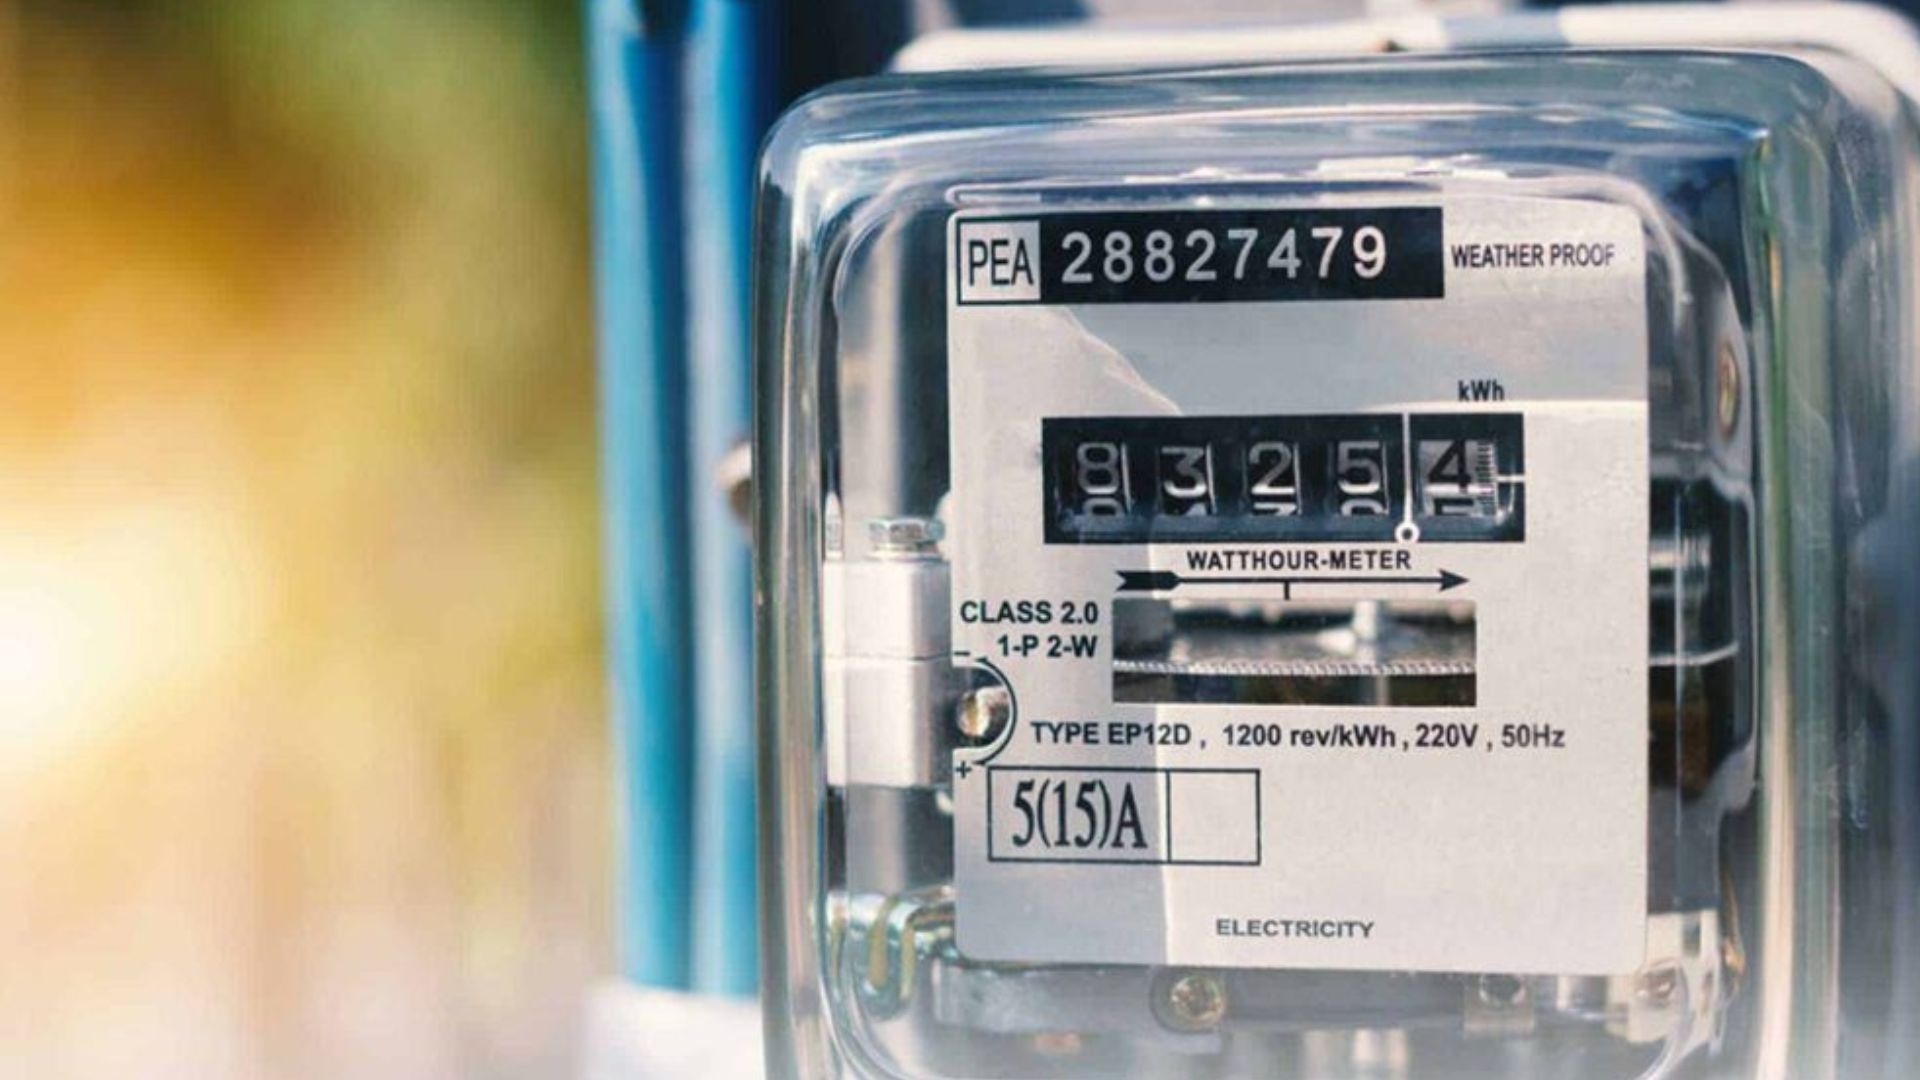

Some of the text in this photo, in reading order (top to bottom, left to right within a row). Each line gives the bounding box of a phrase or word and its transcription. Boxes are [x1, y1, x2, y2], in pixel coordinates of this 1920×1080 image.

[967, 224, 1388, 290] PEA 28827479
[1451, 242, 1616, 270] WEATHER PROOF
[1457, 380, 1506, 402] kWh
[1187, 549, 1413, 572] WATTHOUR-METER
[959, 600, 1099, 626] CLASS 2.0
[997, 633, 1099, 659] 1-P 2-W
[1030, 721, 1100, 746] TYPE
[1222, 722, 1282, 748] 1200
[1500, 723, 1566, 750] 50Hz
[1012, 777, 1149, 851] 5(15)A
[1215, 918, 1375, 940] ELECTRICITY
